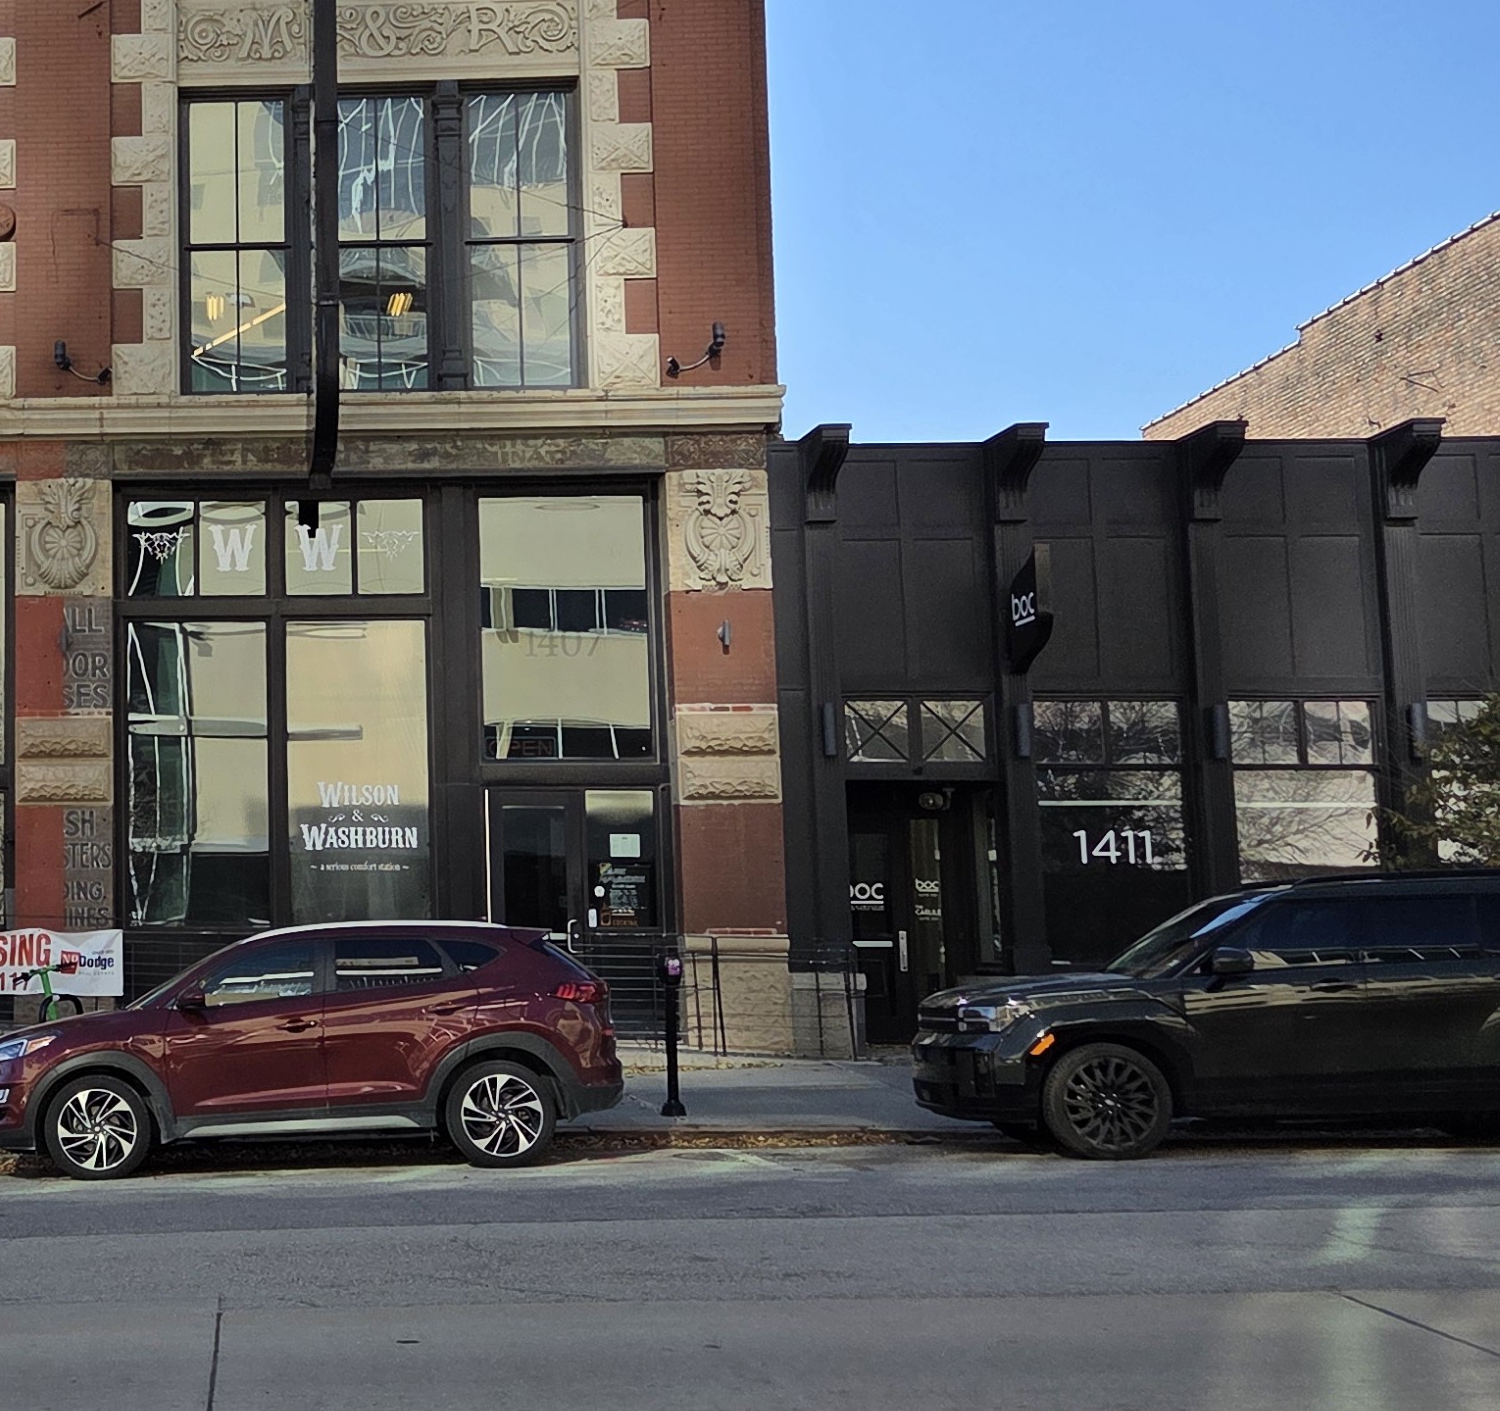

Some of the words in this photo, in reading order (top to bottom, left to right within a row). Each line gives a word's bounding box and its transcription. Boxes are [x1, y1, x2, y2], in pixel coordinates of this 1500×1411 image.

[208, 524, 257, 572] W
[294, 524, 343, 572] W
[1011, 592, 1034, 621] boc
[351, 809, 364, 822] &
[1072, 829, 1153, 865] 1411
[79, 955, 114, 970] Dodge
